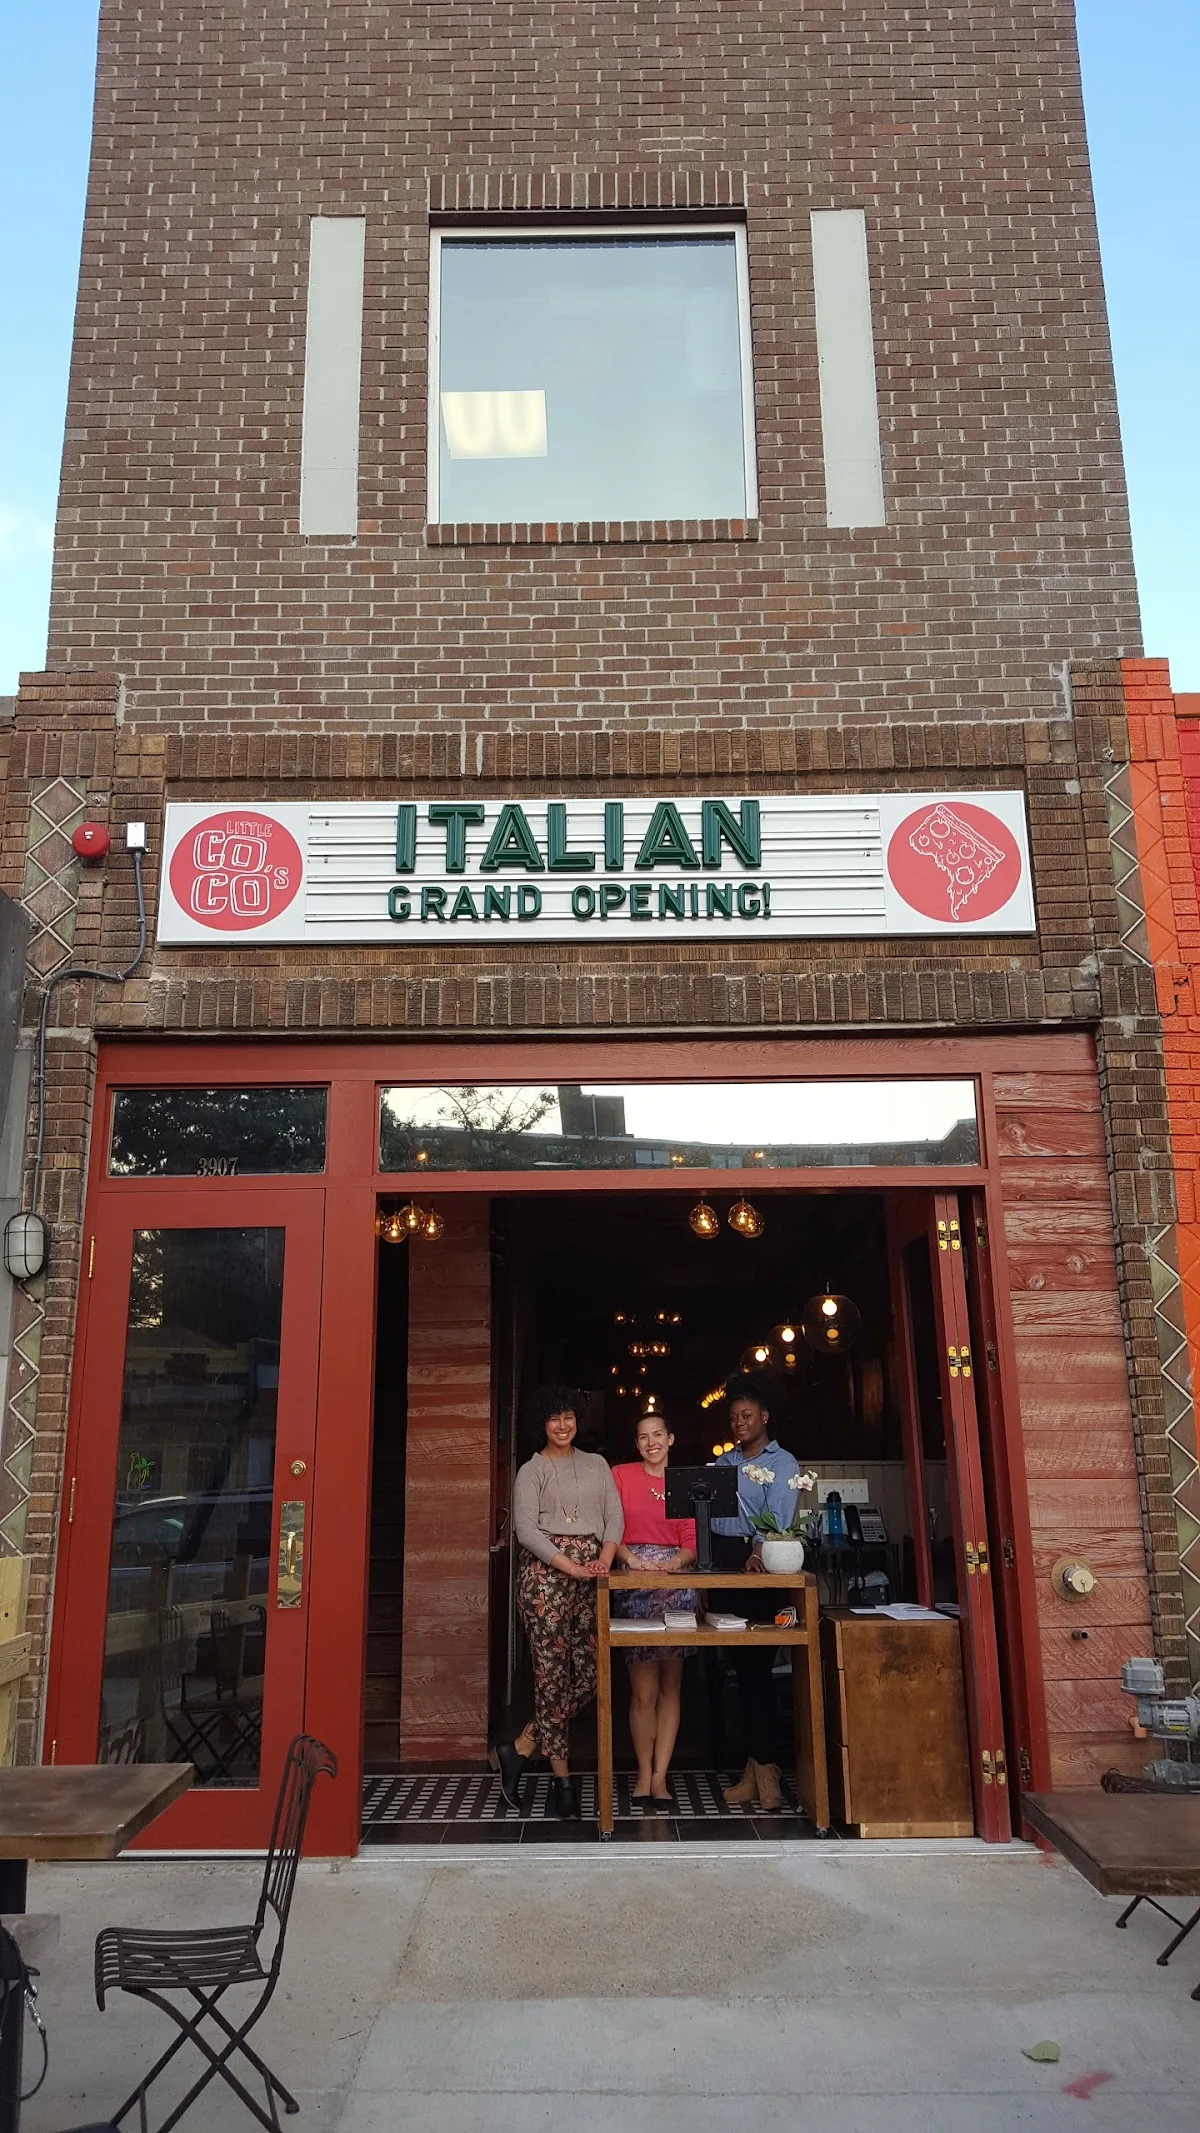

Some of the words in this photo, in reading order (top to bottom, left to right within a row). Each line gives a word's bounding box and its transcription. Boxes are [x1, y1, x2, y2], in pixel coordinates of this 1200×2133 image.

[227, 821, 272, 837] LITTLE
[396, 800, 761, 872] ITALIAN
[193, 831, 268, 873] CO
[388, 886, 542, 920] GRAND
[572, 883, 770, 919] OPENING!
[197, 1157, 238, 1176] 3907
